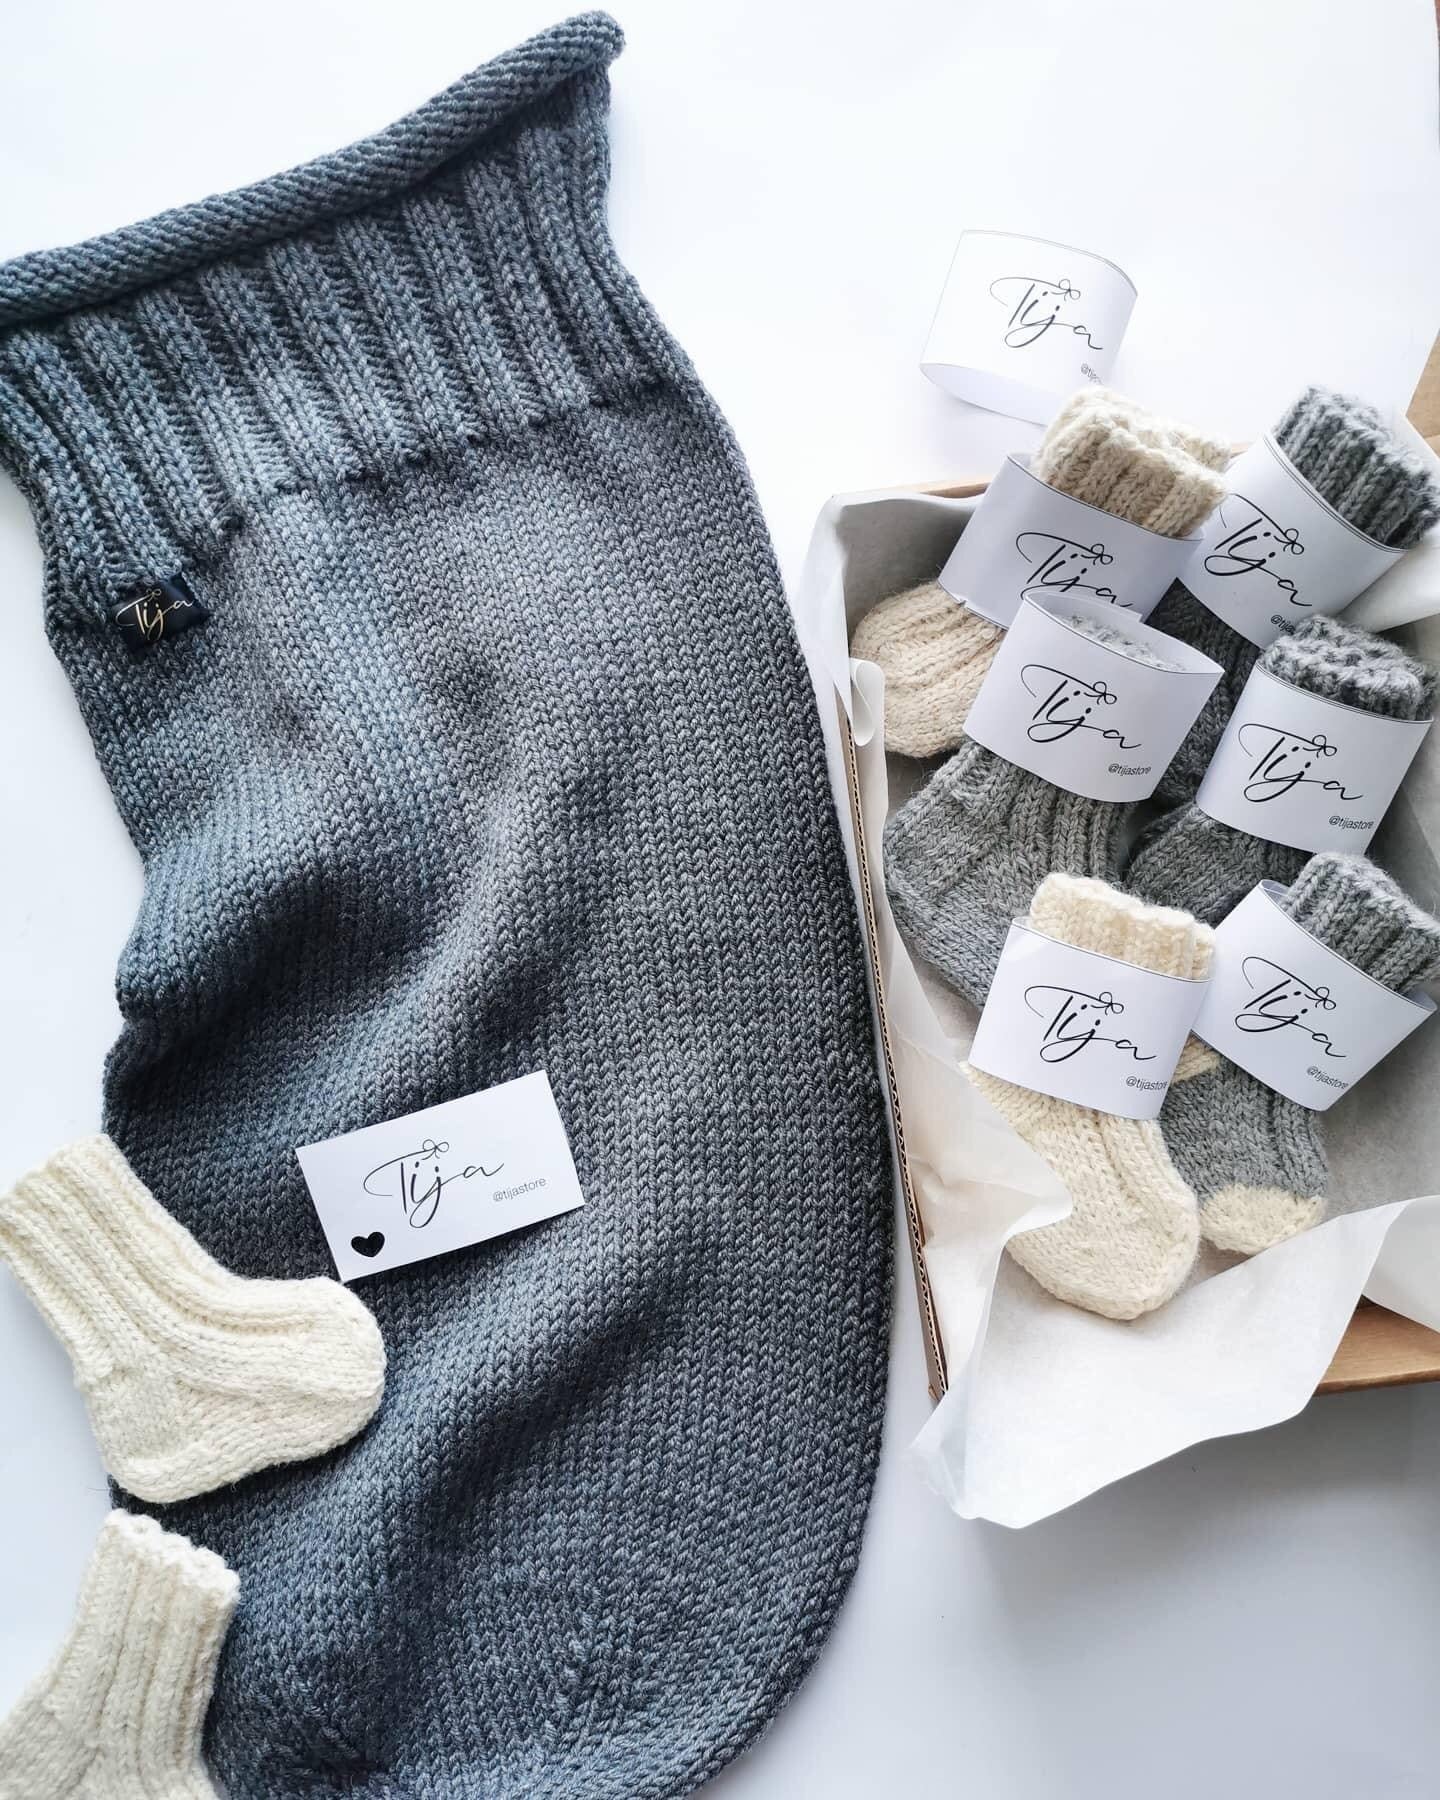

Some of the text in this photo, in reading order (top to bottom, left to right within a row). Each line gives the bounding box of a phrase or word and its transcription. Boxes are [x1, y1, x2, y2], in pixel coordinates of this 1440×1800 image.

[990, 278, 1103, 350] Tija
[1204, 493, 1312, 607] Tija
[1021, 664, 1142, 749] Tija
[1108, 763, 1151, 776] @tijastore
[1238, 723, 1363, 803] Tija
[1329, 815, 1374, 830] @tijastore
[1024, 985, 1157, 1063] Tija
[1235, 956, 1346, 1058] Tija
[1306, 1066, 1349, 1090] @tijastore
[363, 1139, 504, 1229] Tija
[492, 1176, 547, 1202] @tijastore
